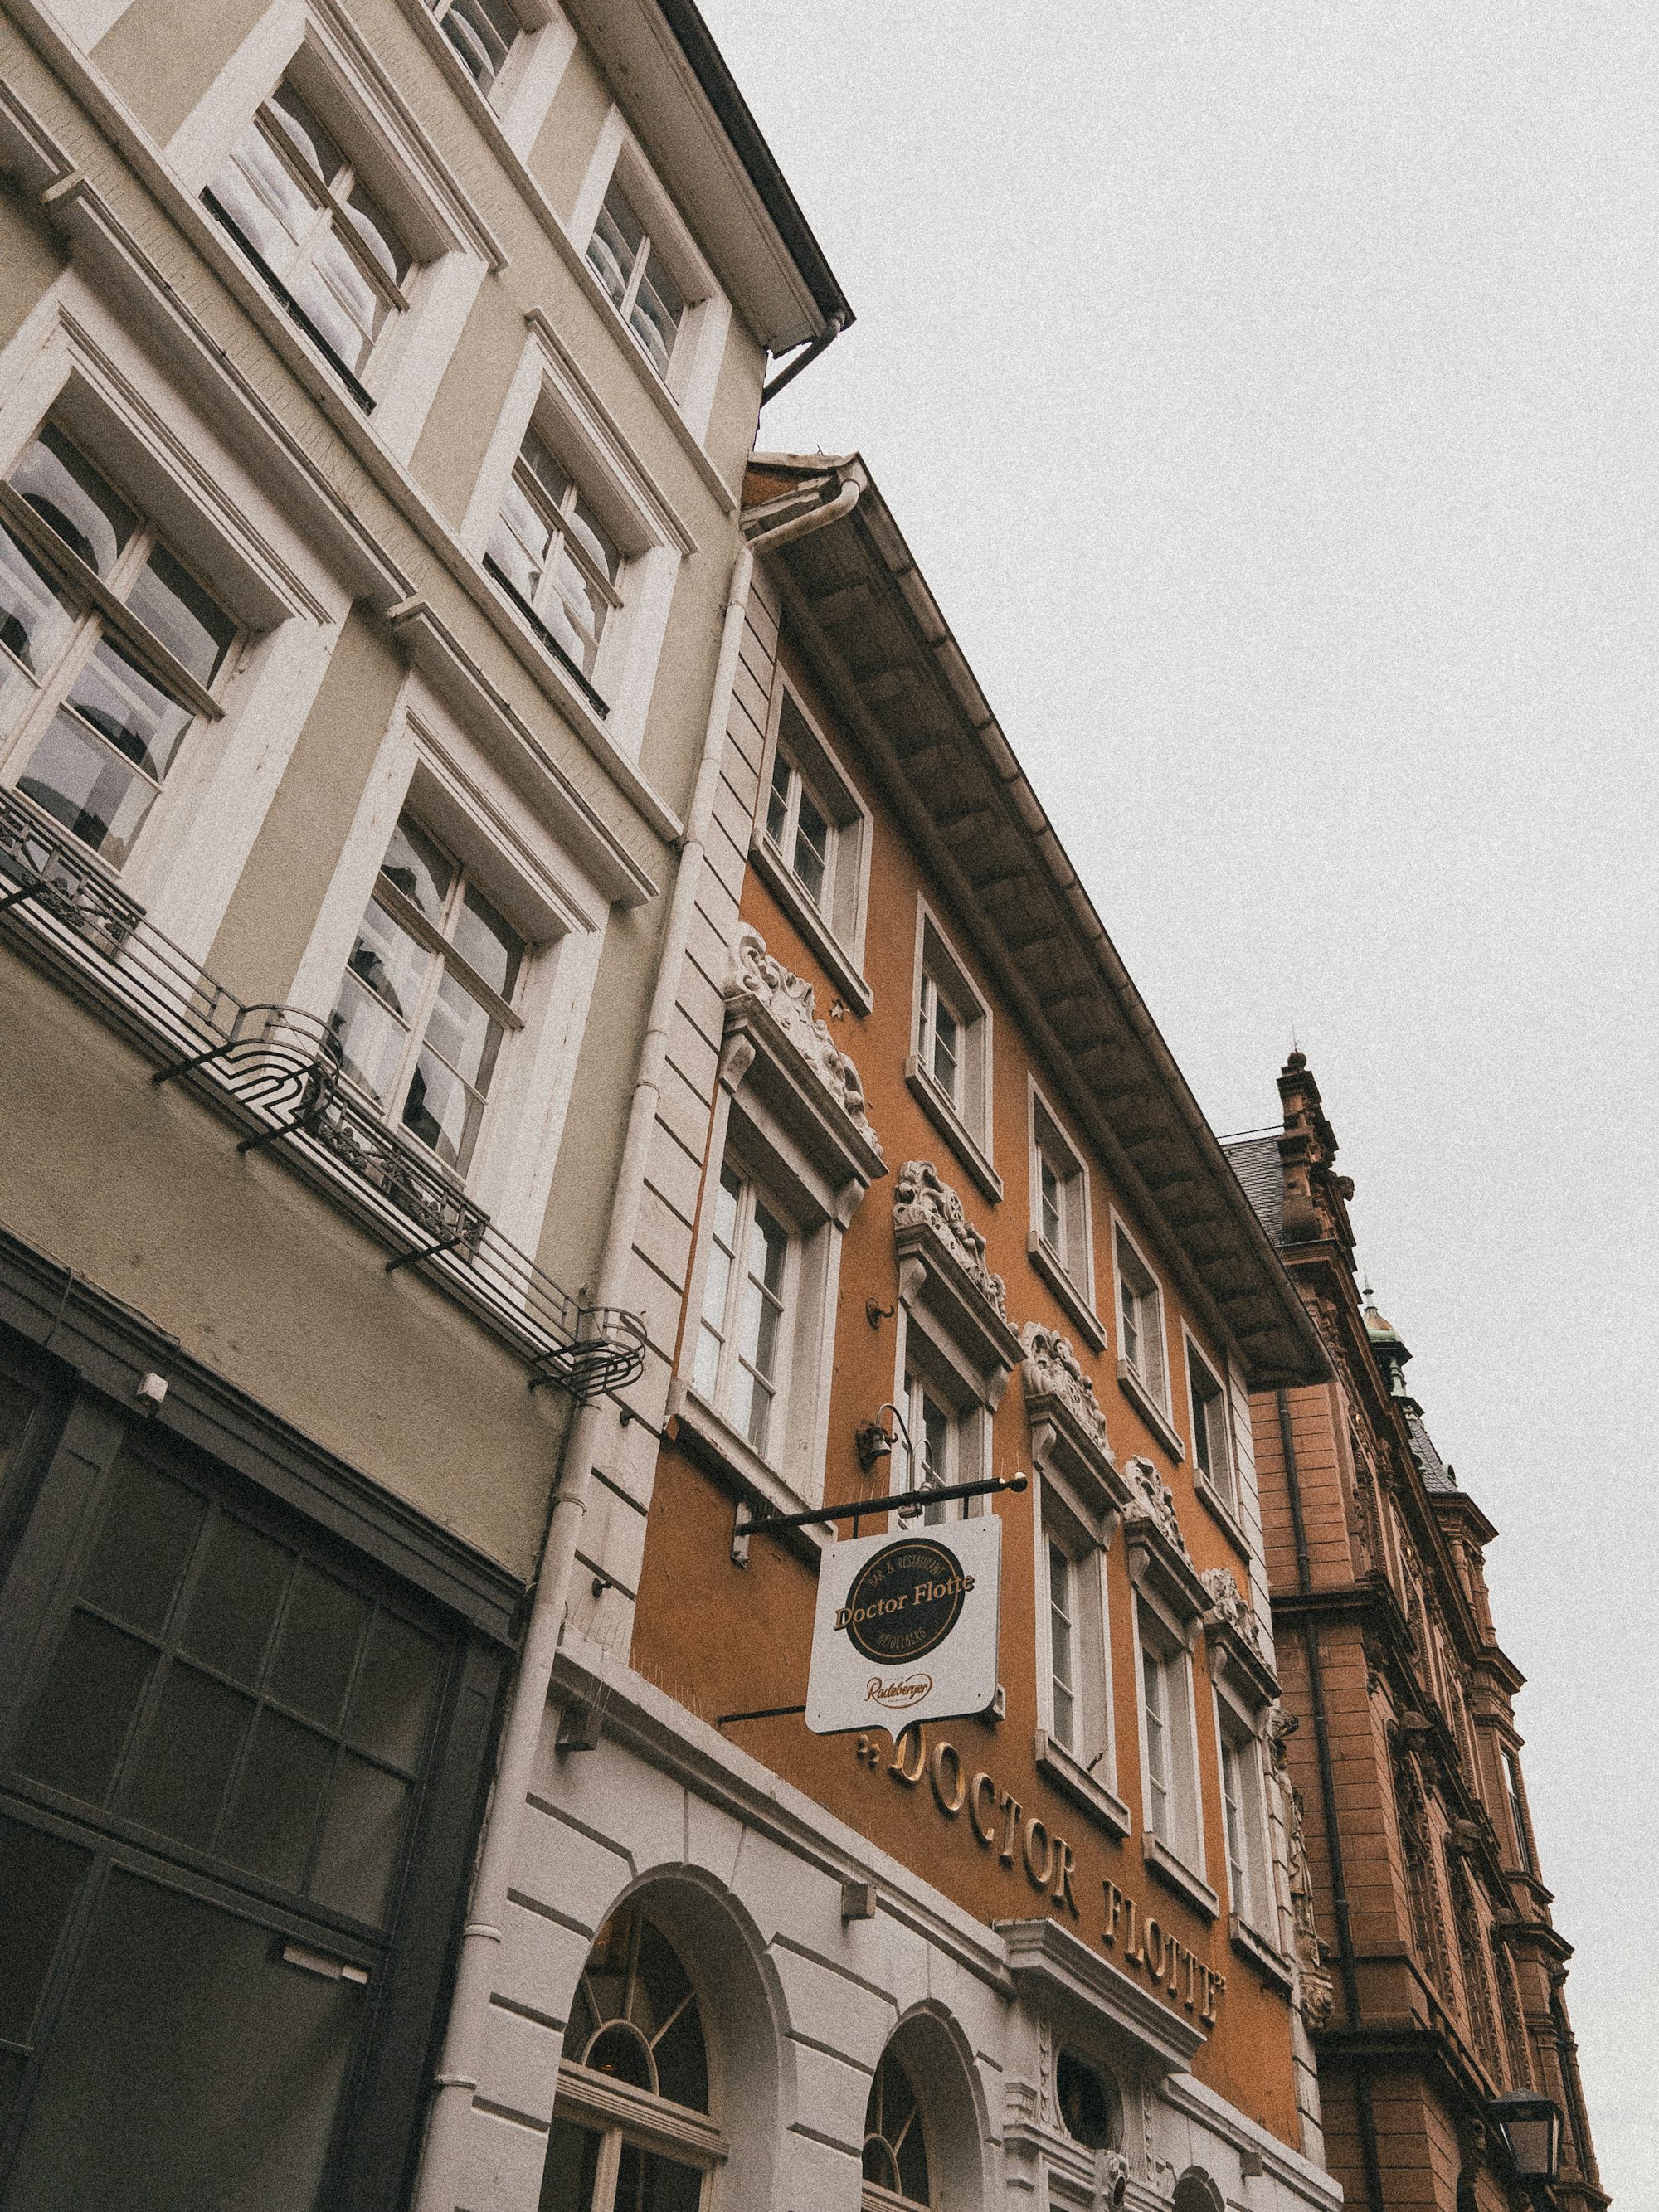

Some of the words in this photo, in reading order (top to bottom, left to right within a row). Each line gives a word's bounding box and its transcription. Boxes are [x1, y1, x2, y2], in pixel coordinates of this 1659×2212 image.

[834, 1593, 908, 1631] Doctor
[913, 1574, 975, 1606] Flotte
[877, 1626, 927, 1649] HEIDELBERG
[864, 1675, 930, 1704] Radeberger
